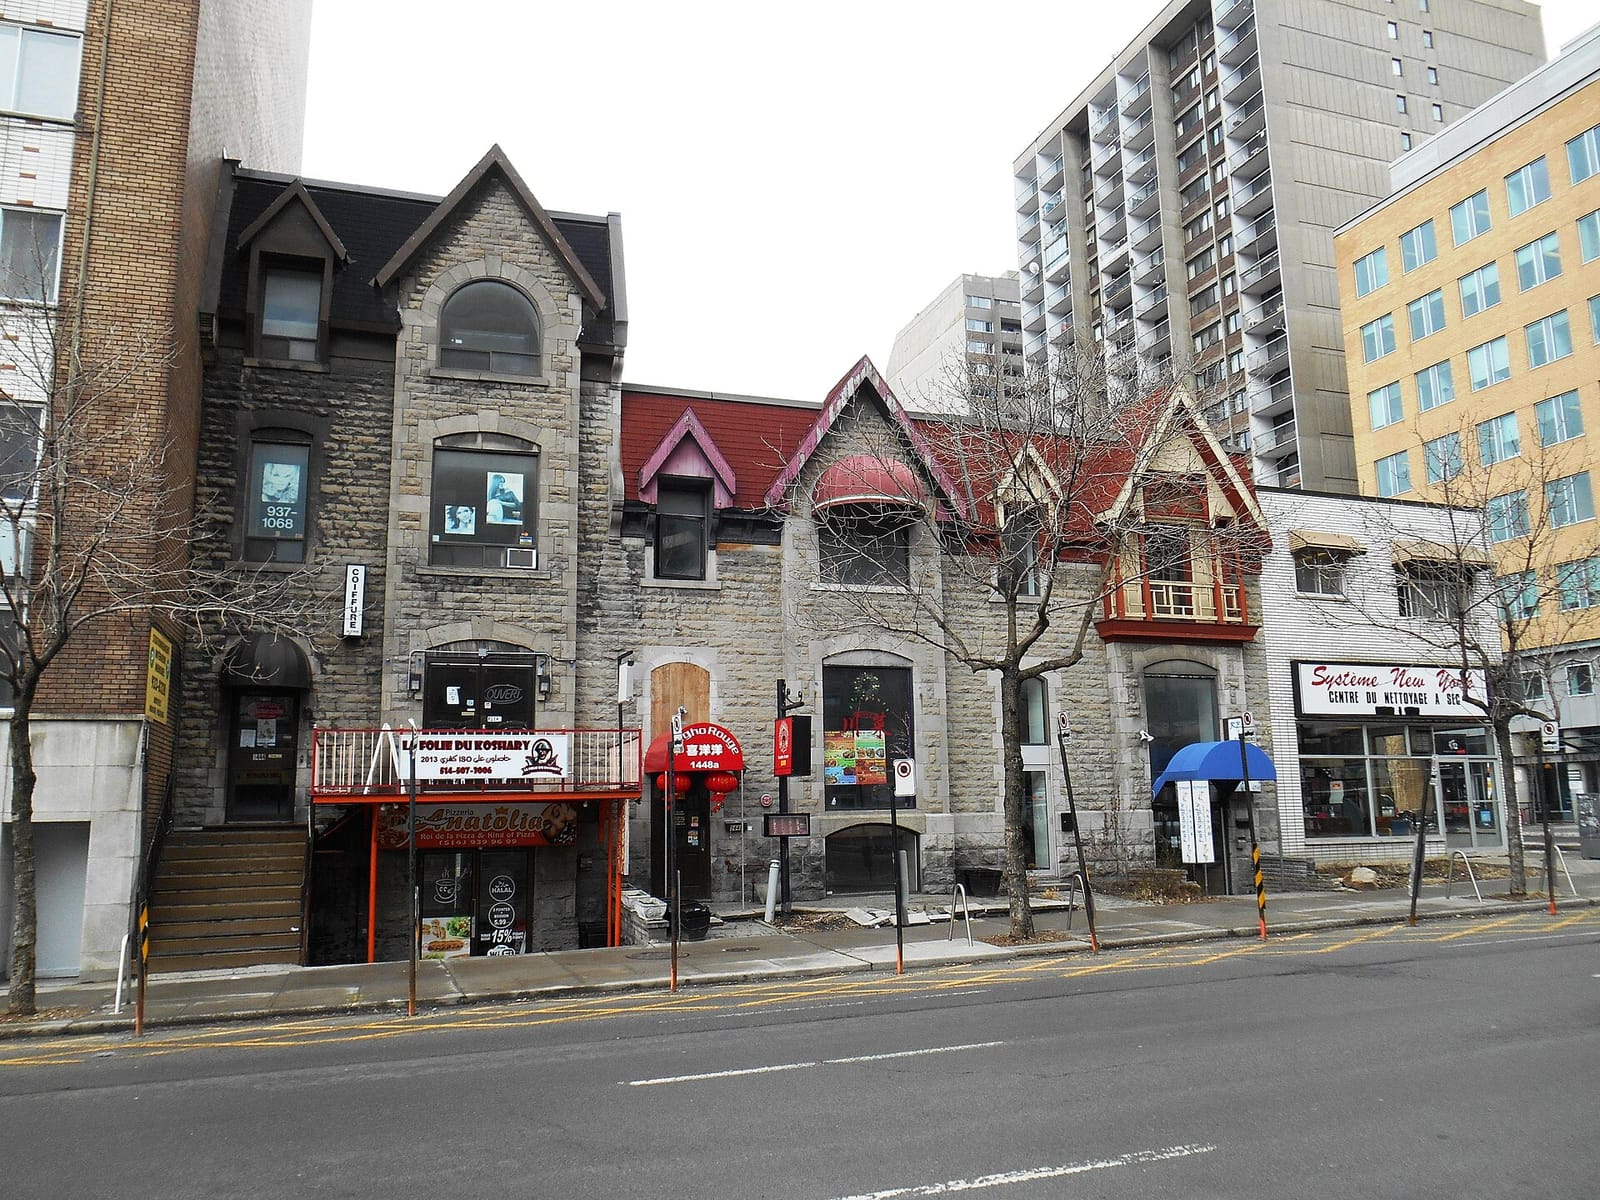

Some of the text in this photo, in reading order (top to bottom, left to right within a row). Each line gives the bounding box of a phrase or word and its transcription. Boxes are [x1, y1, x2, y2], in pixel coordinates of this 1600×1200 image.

[267, 506, 298, 517] 937-
[262, 518, 294, 529] 1068
[349, 569, 360, 629] COIFFURE
[1311, 665, 1379, 690] Système
[1390, 667, 1425, 688] New
[1328, 691, 1359, 704] CENTRE
[1366, 691, 1377, 704] DU
[1384, 692, 1428, 705] NETTOYAGE
[1446, 693, 1461, 706] SEC
[419, 740, 453, 751] FOLIE
[455, 740, 473, 751] DU
[474, 740, 531, 751] KOSHARY
[707, 726, 740, 756] Rouge
[690, 761, 720, 769] 1448a
[412, 807, 544, 832] Anatolia
[445, 808, 474, 816] Pizzeria
[491, 928, 513, 944] 15%
